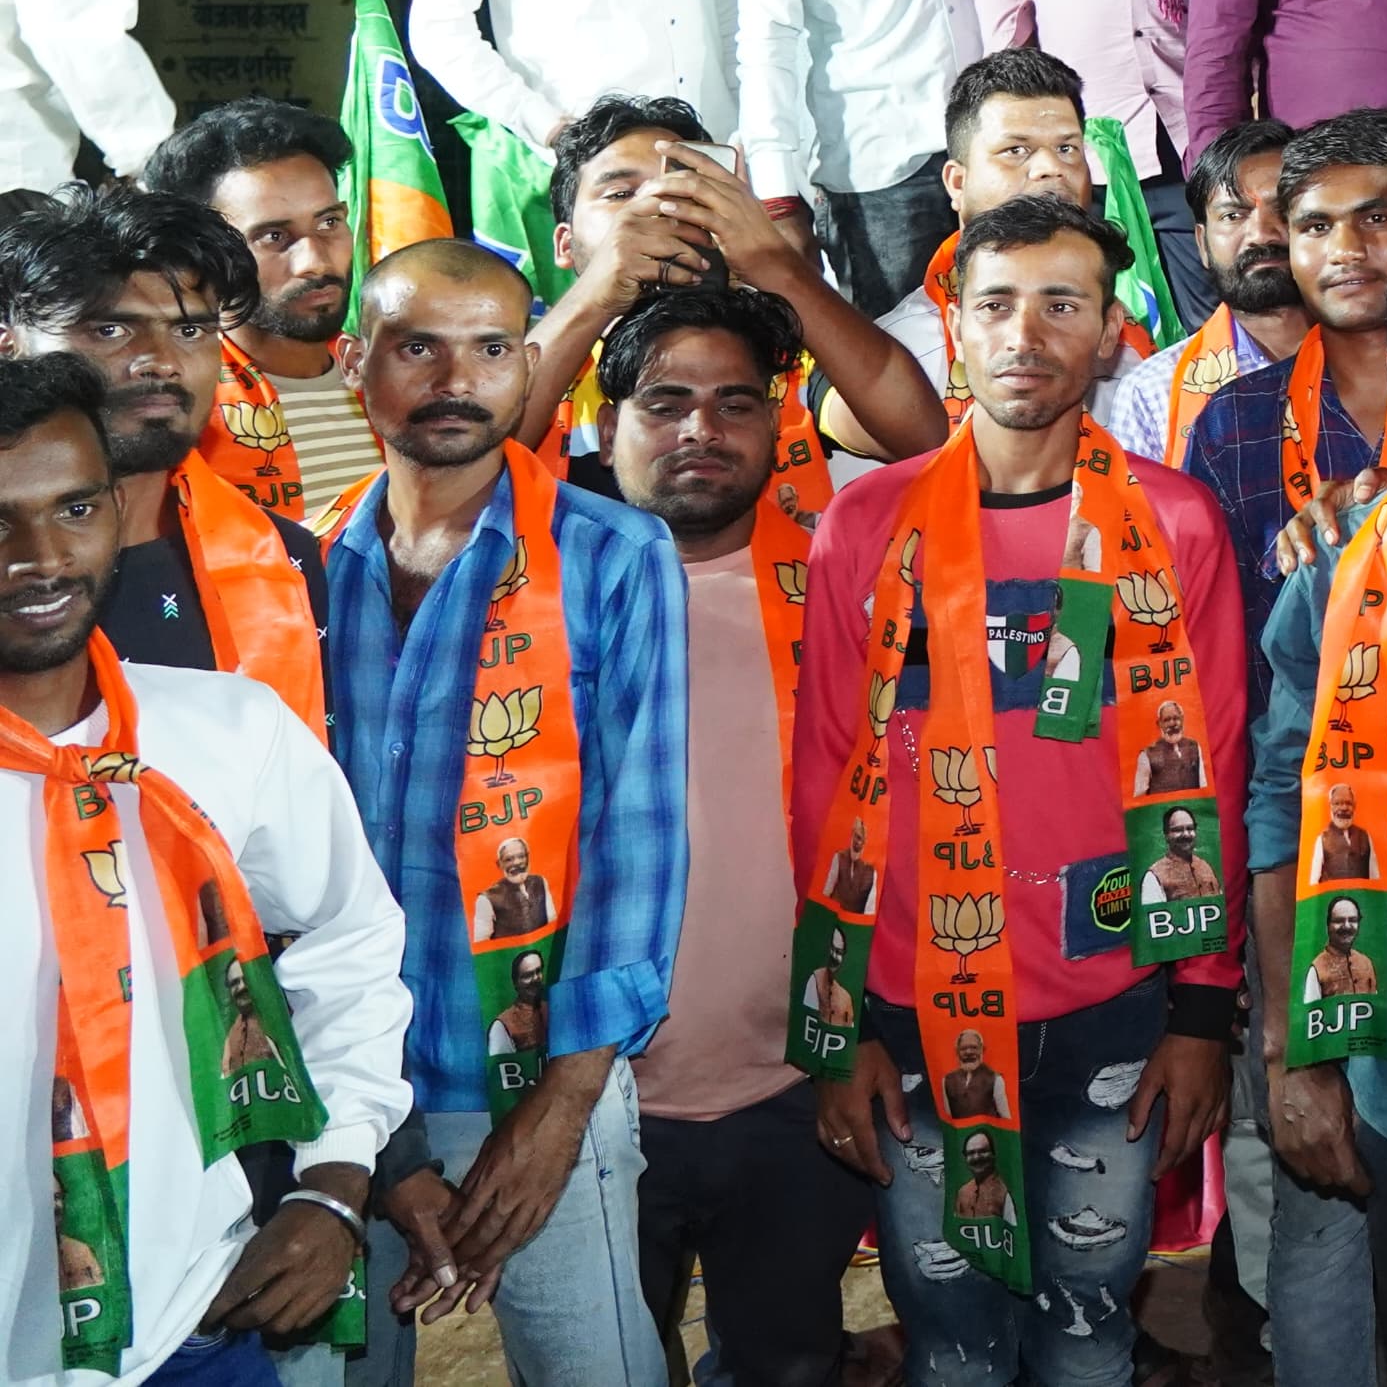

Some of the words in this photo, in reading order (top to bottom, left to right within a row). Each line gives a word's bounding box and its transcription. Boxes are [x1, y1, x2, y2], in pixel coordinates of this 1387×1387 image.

[480, 632, 532, 669] JP
[988, 628, 1045, 644] PALESTINO
[1129, 657, 1193, 695] BJP
[460, 787, 542, 834] BJP
[1149, 904, 1221, 939] BJP
[1307, 1002, 1375, 1040] BJP
